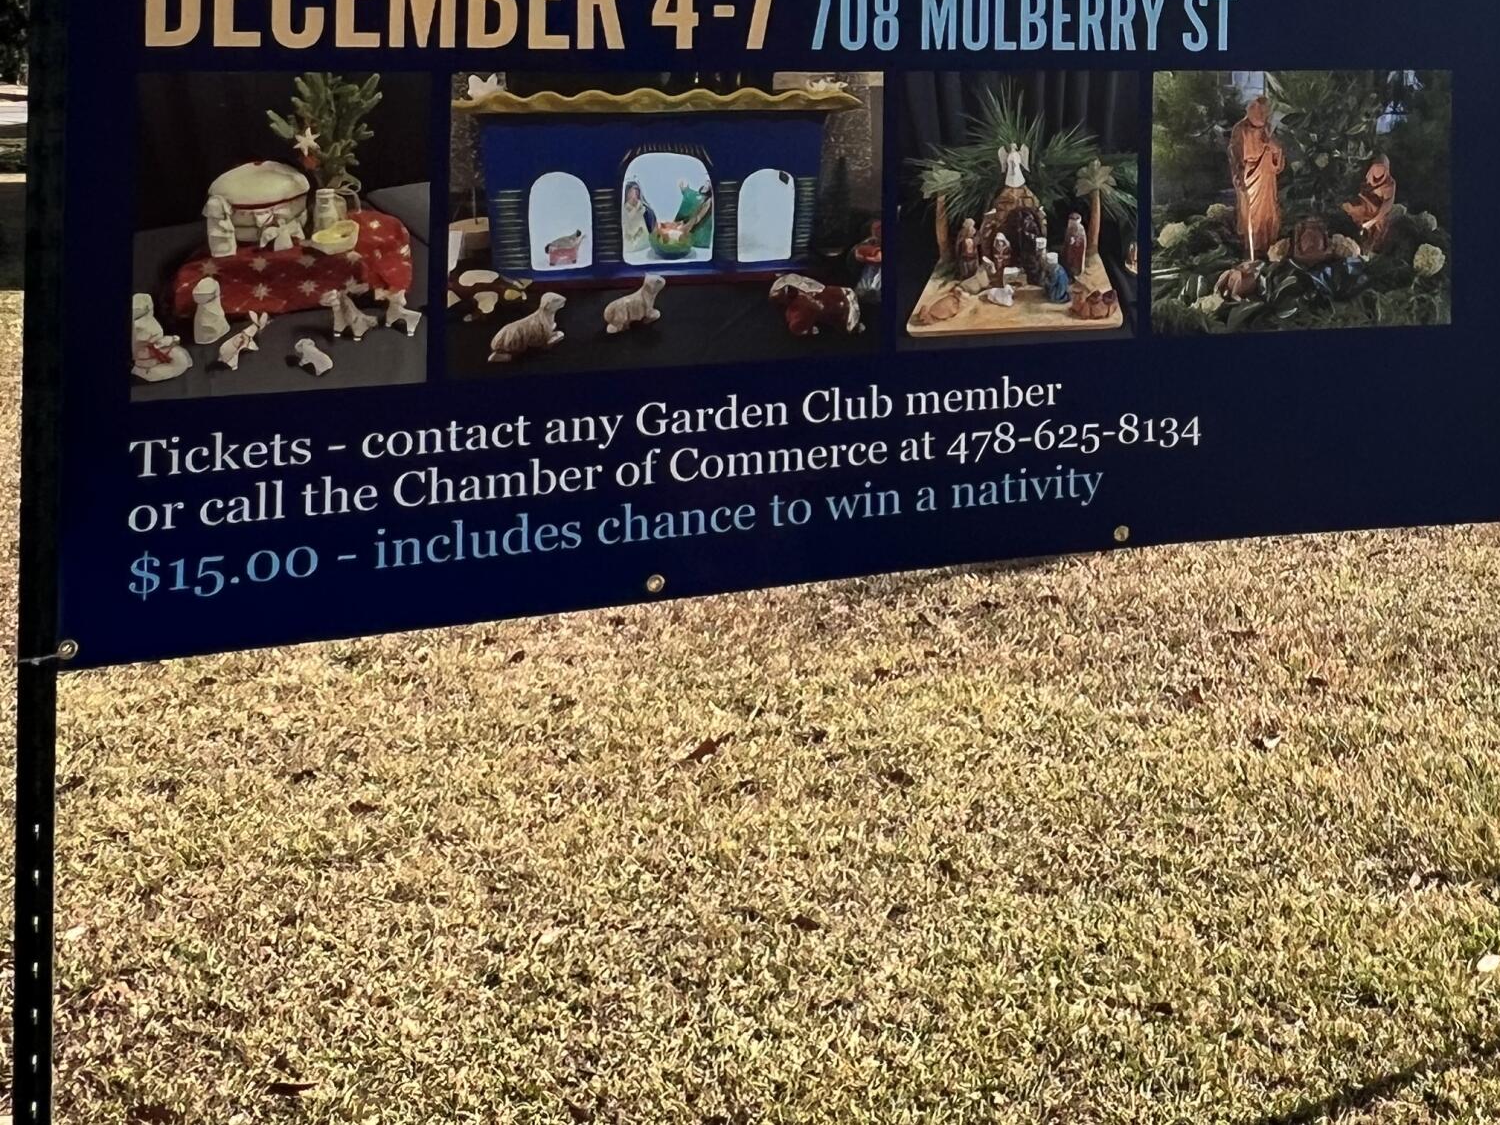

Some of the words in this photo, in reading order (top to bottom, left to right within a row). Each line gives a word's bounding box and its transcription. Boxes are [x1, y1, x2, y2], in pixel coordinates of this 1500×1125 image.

[127, 501, 185, 533] or
[199, 479, 286, 526] call
[301, 475, 378, 517] the
[393, 458, 603, 507] Chamber
[615, 447, 661, 487] of
[669, 441, 888, 483] Commerce
[899, 431, 936, 462] at
[945, 413, 1202, 465] 478-625-8134
[128, 431, 312, 478] Tickets
[361, 415, 532, 459] contact
[544, 414, 624, 450] any
[635, 393, 789, 437] Garden
[802, 384, 893, 424] Club
[905, 375, 1063, 416] member
[128, 546, 318, 601] $15.00
[374, 512, 582, 569] includes
[597, 502, 756, 545] chance
[769, 494, 812, 527] to
[825, 480, 902, 521] win
[916, 486, 937, 512] a
[951, 464, 1104, 509] nativity
